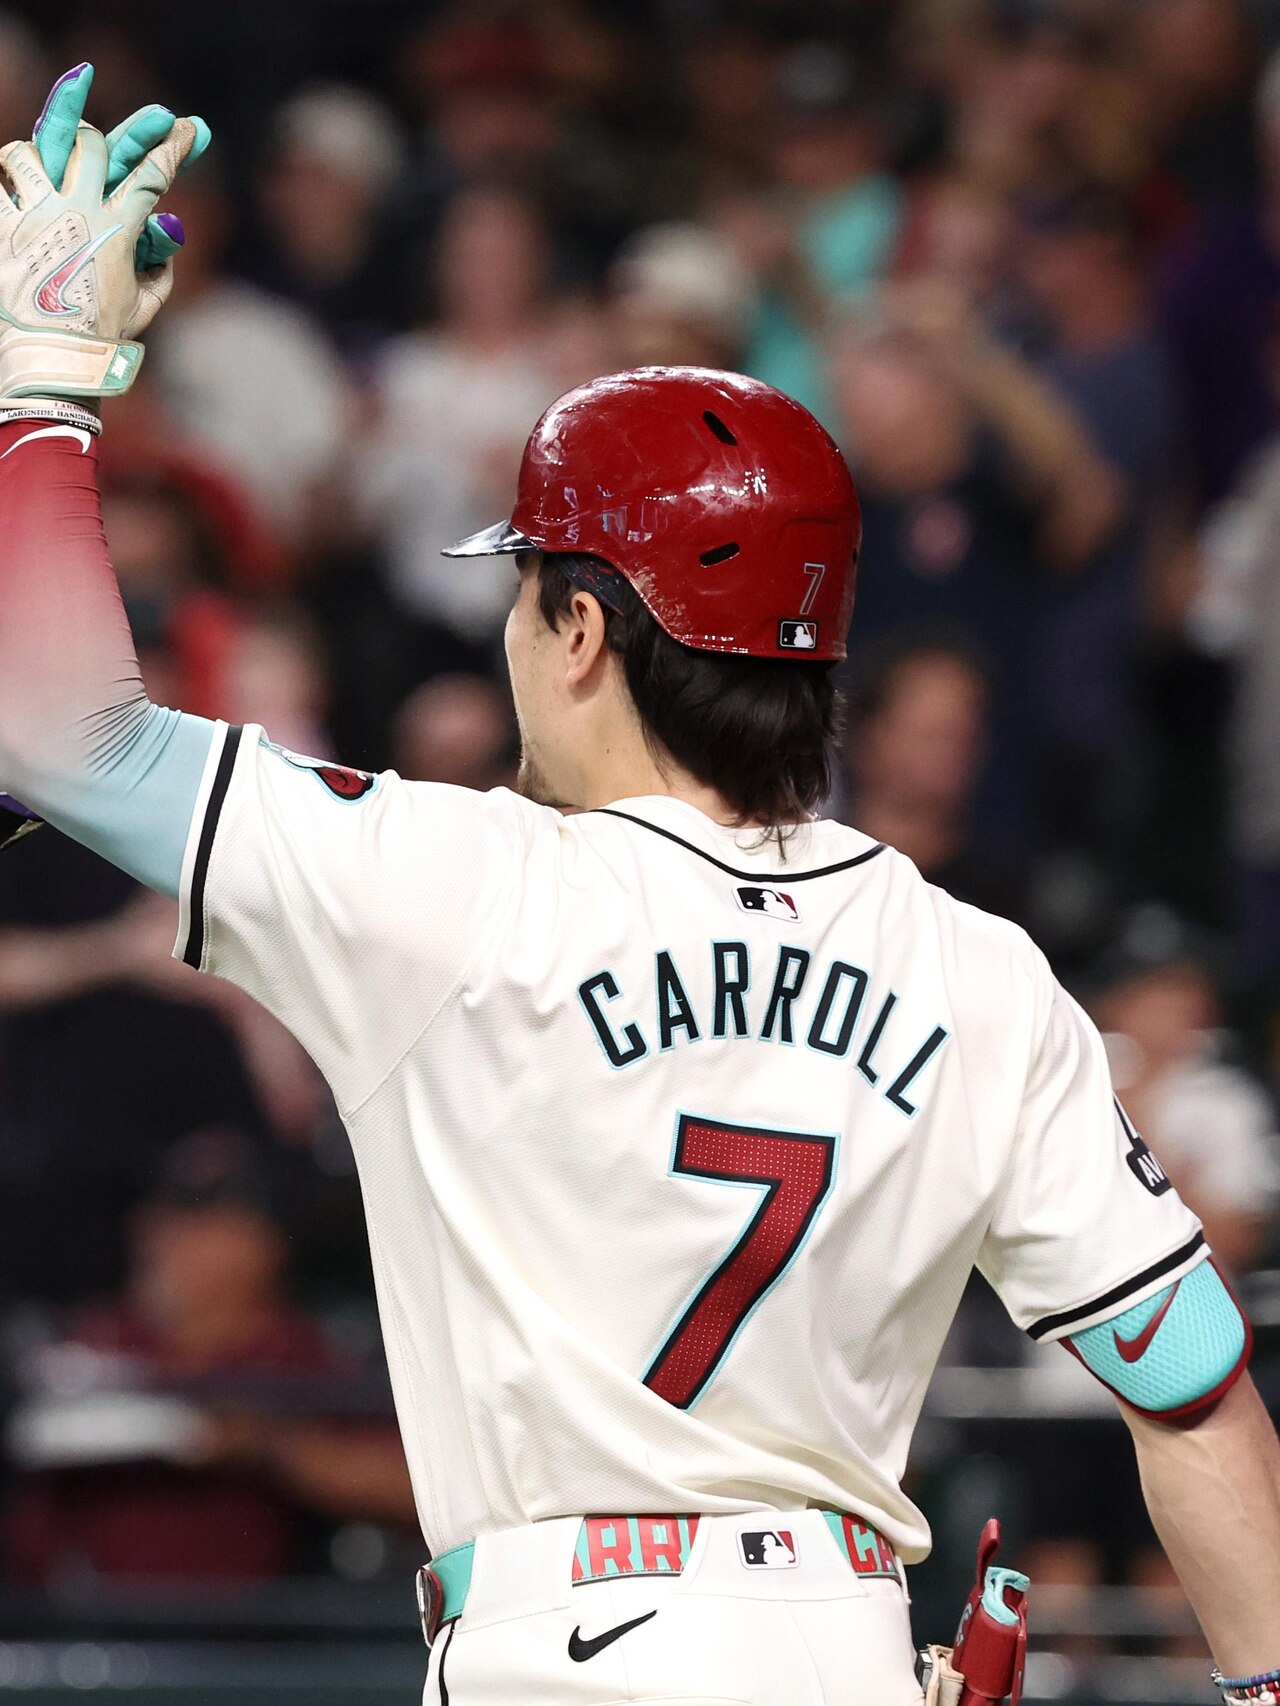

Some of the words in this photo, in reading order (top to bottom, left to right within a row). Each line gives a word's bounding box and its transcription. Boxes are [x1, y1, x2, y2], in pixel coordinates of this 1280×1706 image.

[7, 409, 54, 419] LAKESIDE
[57, 410, 99, 425] BASEBALL
[799, 562, 826, 615] 7
[576, 938, 952, 1120] CARROLL
[639, 1108, 841, 1415] 7
